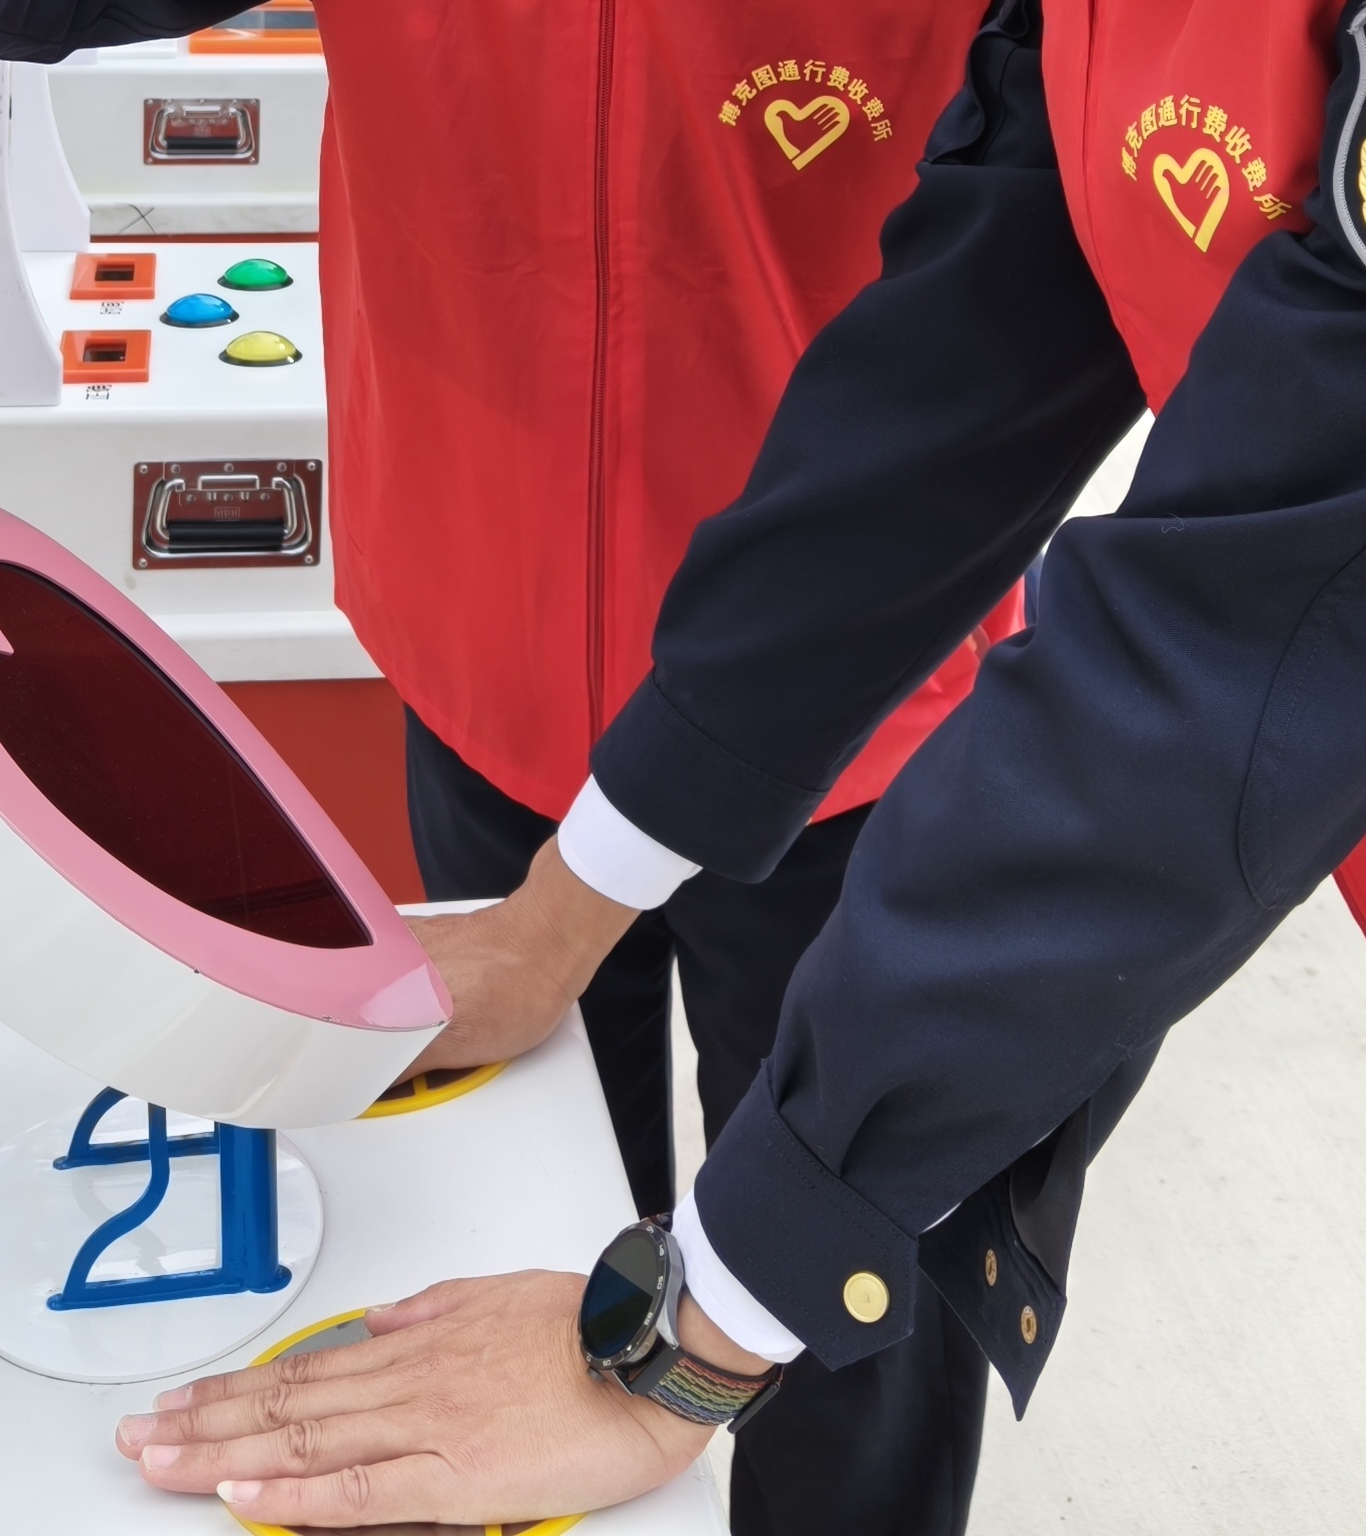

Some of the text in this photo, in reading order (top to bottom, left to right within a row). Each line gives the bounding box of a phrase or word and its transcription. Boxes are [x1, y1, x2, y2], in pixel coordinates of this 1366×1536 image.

[718, 58, 893, 142] 博克图通行费收费所
